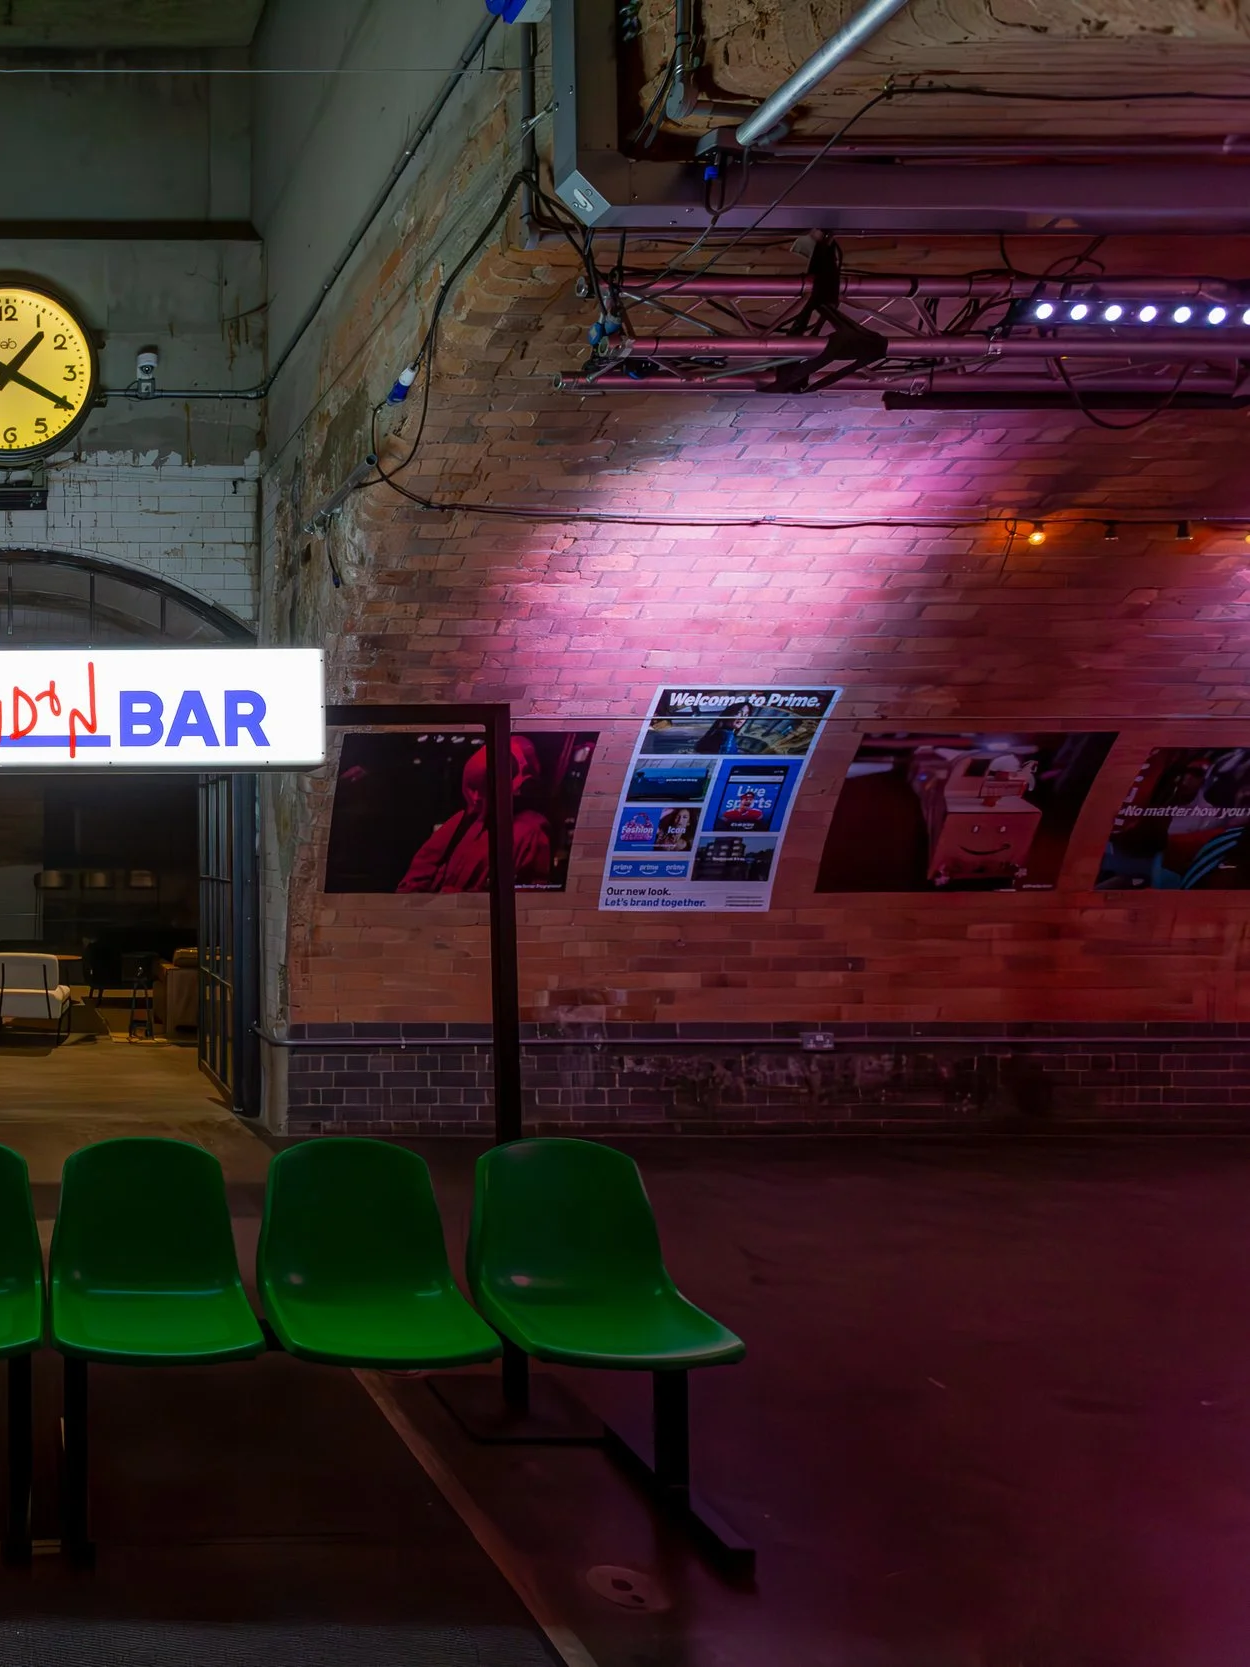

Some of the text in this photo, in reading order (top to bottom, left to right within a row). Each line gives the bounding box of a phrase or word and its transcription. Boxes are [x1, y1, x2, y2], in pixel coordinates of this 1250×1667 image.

[53, 334, 68, 350] 2
[63, 365, 77, 381] 3
[34, 418, 48, 434] 5
[3, 427, 17, 443] 6
[669, 692, 821, 707] Welcome to Prime.
[119, 690, 271, 747] BAR
[726, 797, 772, 809] sprts
[1124, 805, 1144, 816] No
[1143, 805, 1191, 816] matter
[1191, 805, 1221, 817] how
[1218, 807, 1246, 819] you
[621, 825, 654, 834] Fashion
[667, 825, 687, 834] Icon
[606, 887, 671, 896] Our new look.
[605, 898, 707, 908] Let's brand together.
